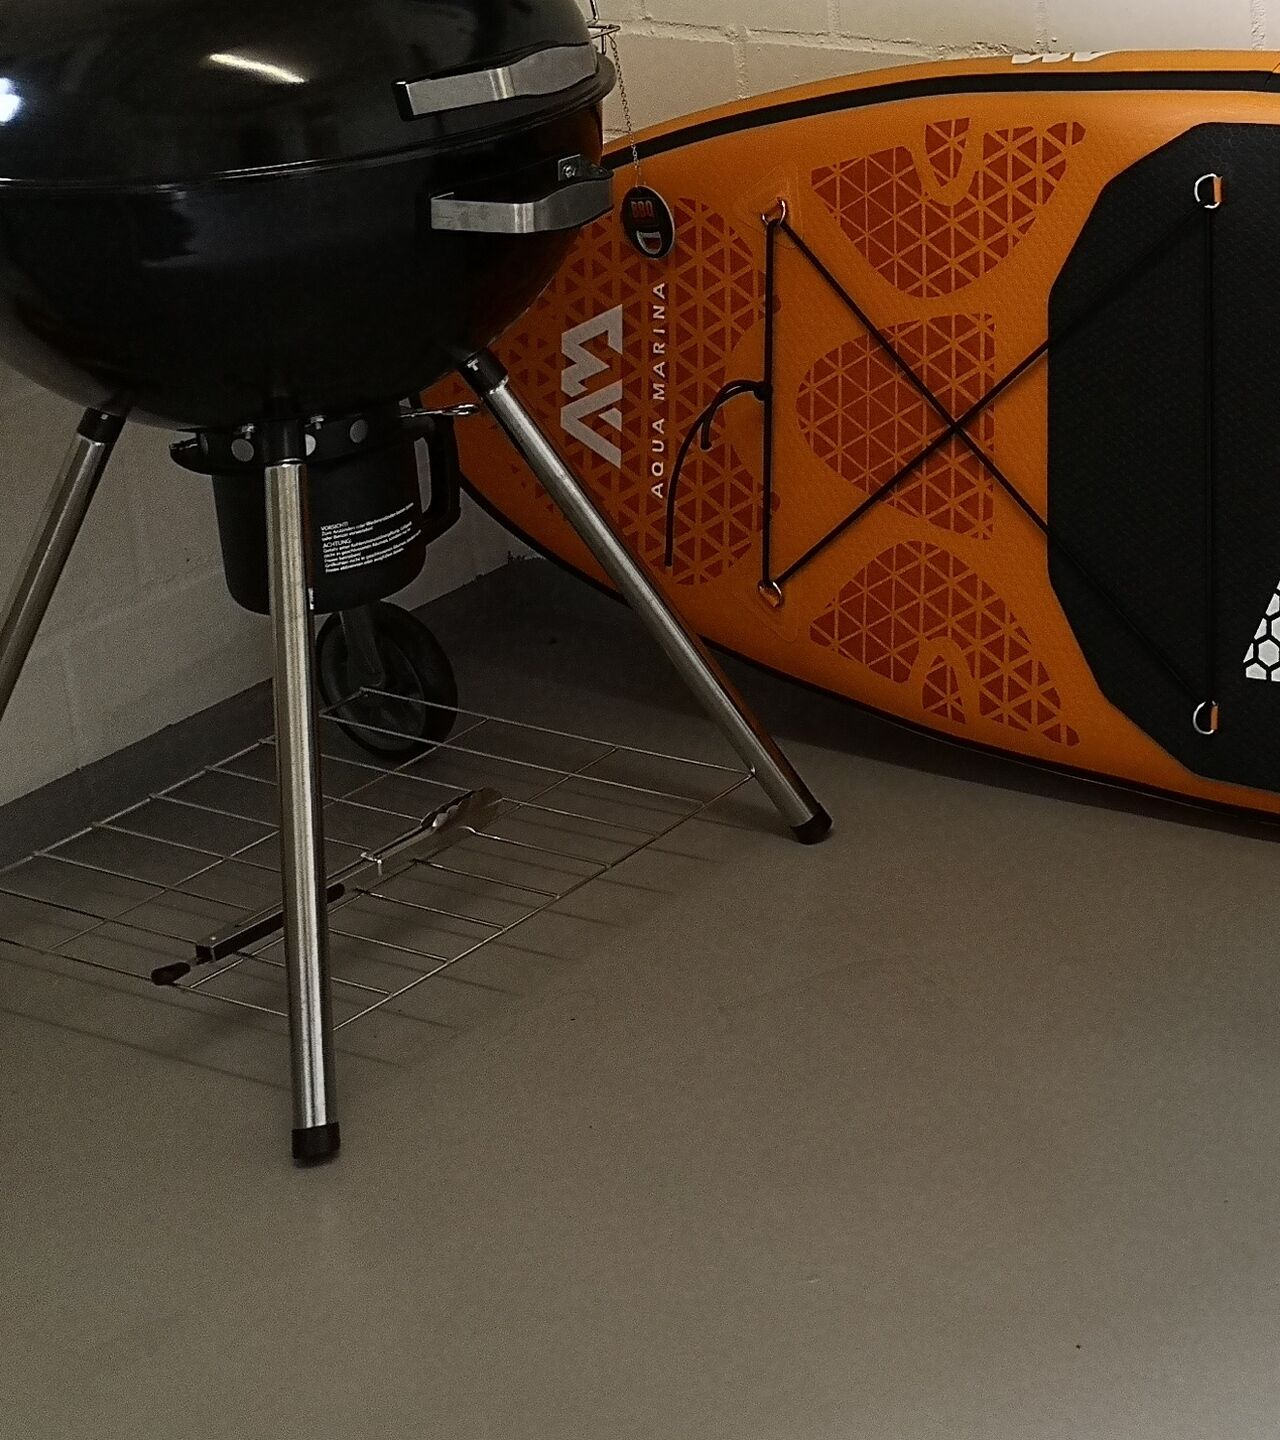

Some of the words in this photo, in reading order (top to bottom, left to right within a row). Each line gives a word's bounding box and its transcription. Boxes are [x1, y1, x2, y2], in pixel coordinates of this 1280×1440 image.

[630, 200, 655, 219] BBQ
[652, 282, 665, 401] MARINA
[651, 417, 665, 499] AQUA
